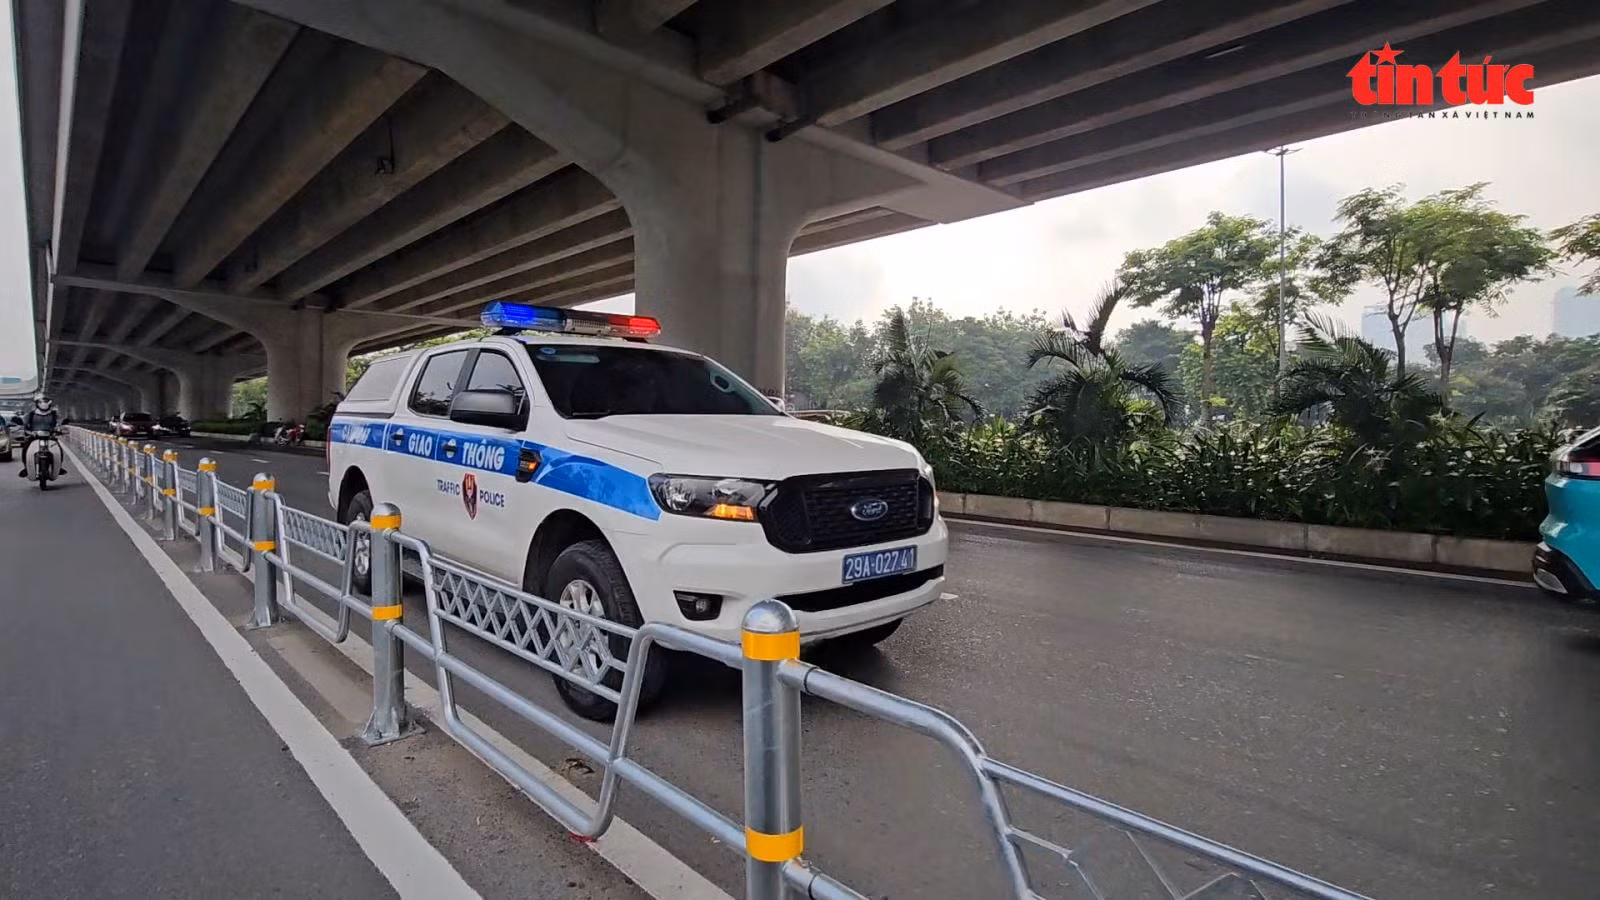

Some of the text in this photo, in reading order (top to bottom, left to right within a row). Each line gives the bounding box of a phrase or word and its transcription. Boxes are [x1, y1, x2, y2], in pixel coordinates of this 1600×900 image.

[408, 432, 505, 470] GIAO THÔNG
[437, 479, 505, 508] TRAFFIC POLICE
